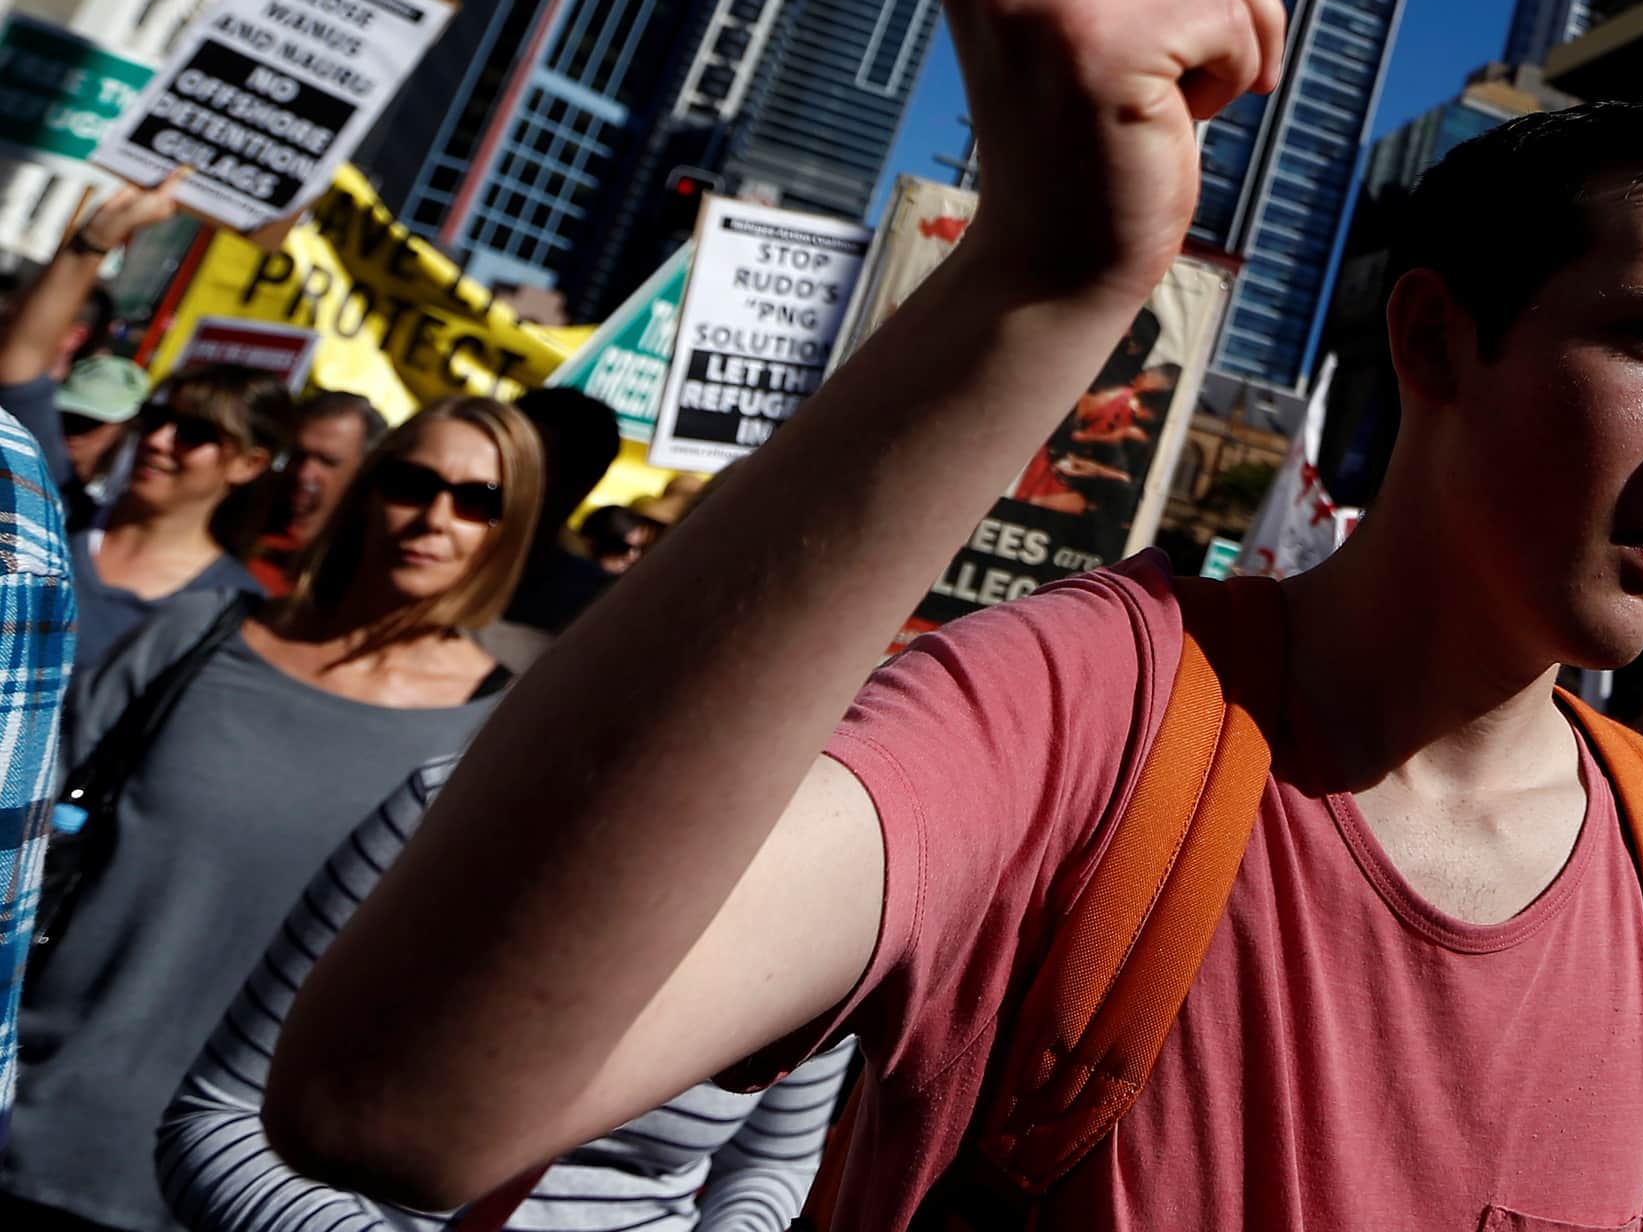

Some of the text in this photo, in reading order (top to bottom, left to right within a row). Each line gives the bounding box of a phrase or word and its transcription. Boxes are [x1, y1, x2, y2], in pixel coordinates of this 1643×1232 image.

[213, 13, 376, 95] AND NAURU
[262, 2, 365, 56] MANUS
[172, 68, 335, 153] OFFSHORE
[242, 66, 304, 105] NO
[148, 92, 315, 179] DETENTION
[152, 128, 279, 199] GULAGS
[757, 243, 830, 269] STOP
[733, 267, 840, 306] RUDD'S
[238, 250, 530, 400] PROTECT
[704, 354, 763, 386] LET
[970, 518, 1104, 572] EES are
